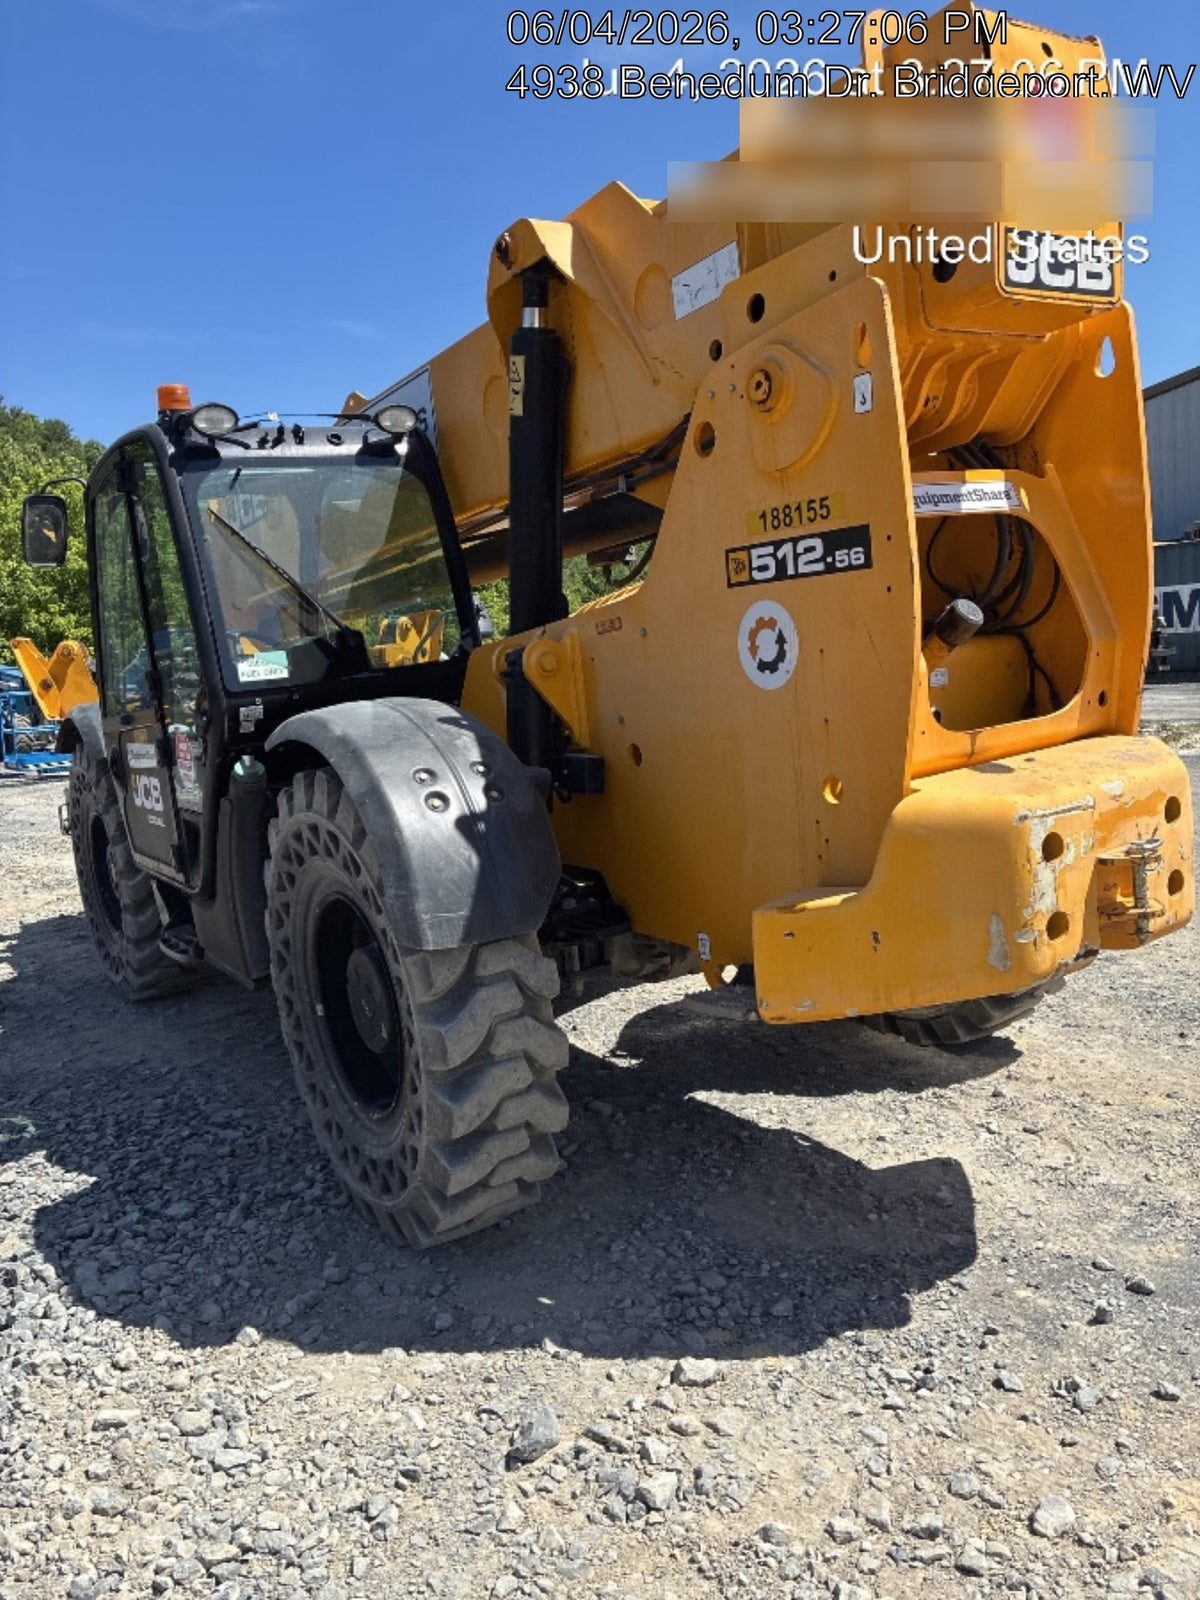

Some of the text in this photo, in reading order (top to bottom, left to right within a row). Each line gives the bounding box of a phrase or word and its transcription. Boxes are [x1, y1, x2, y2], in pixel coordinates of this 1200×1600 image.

[759, 496, 830, 532] 188155
[913, 488, 1012, 508] quipmentShare
[133, 774, 163, 811] JCB
